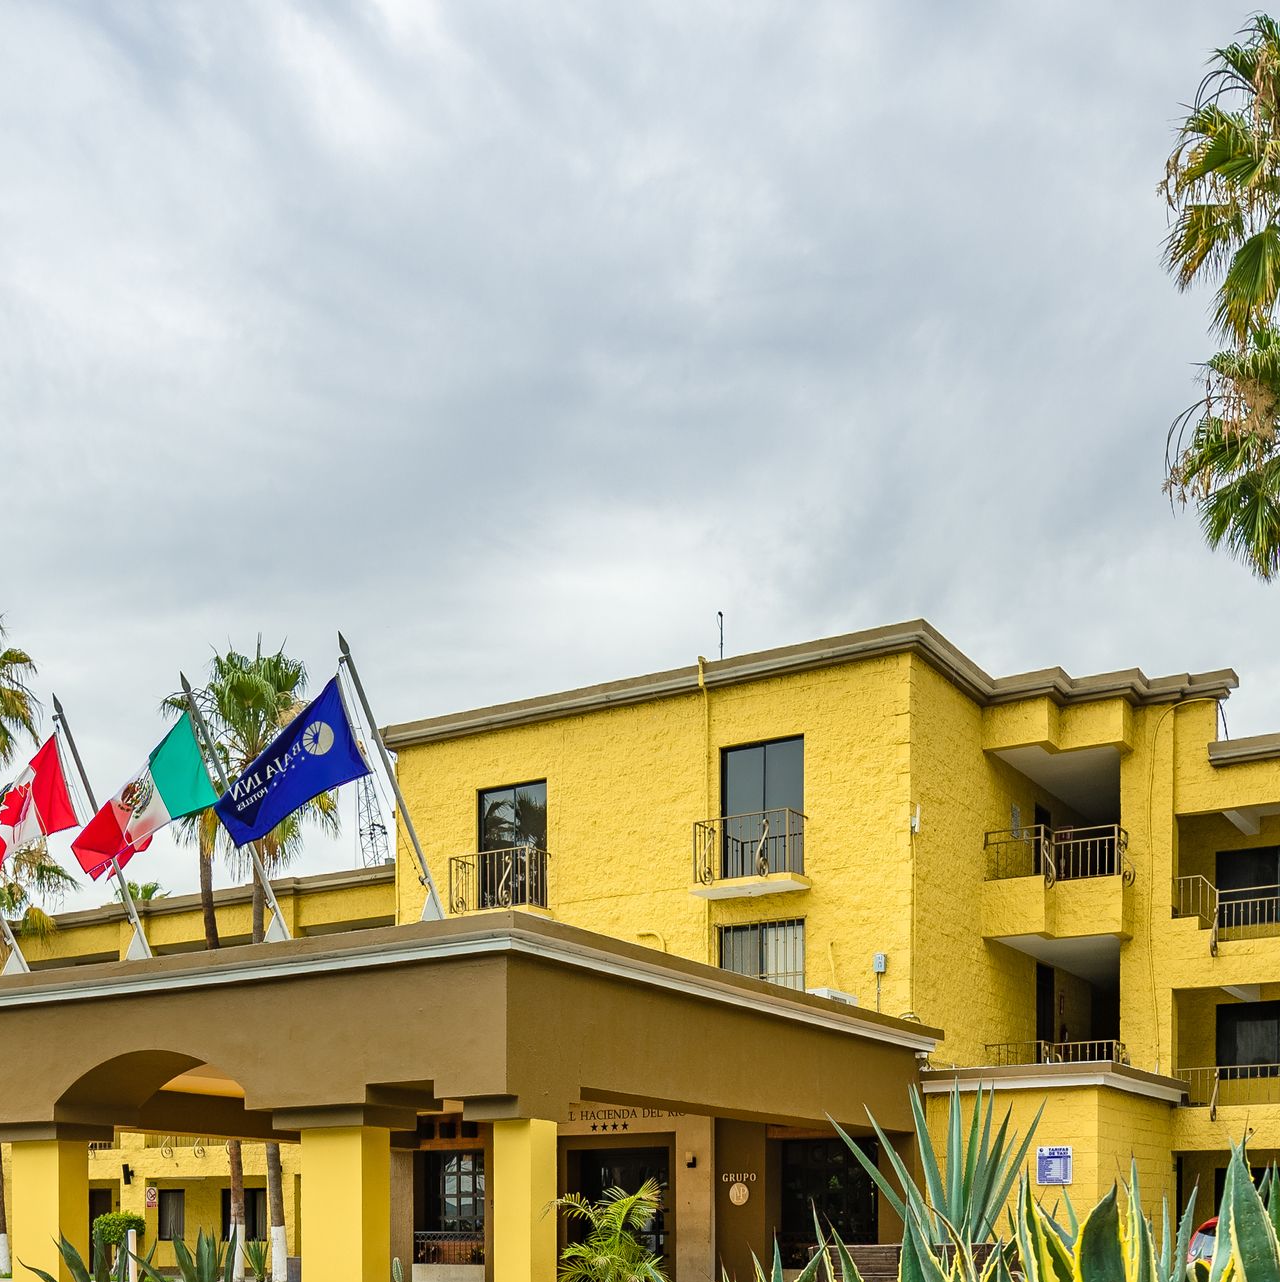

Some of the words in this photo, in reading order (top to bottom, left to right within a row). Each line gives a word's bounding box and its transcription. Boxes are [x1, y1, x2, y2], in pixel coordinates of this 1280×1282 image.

[580, 1108, 638, 1120] HACIENDA
[642, 1108, 663, 1118] DEL
[722, 1173, 757, 1182] GRUPO
